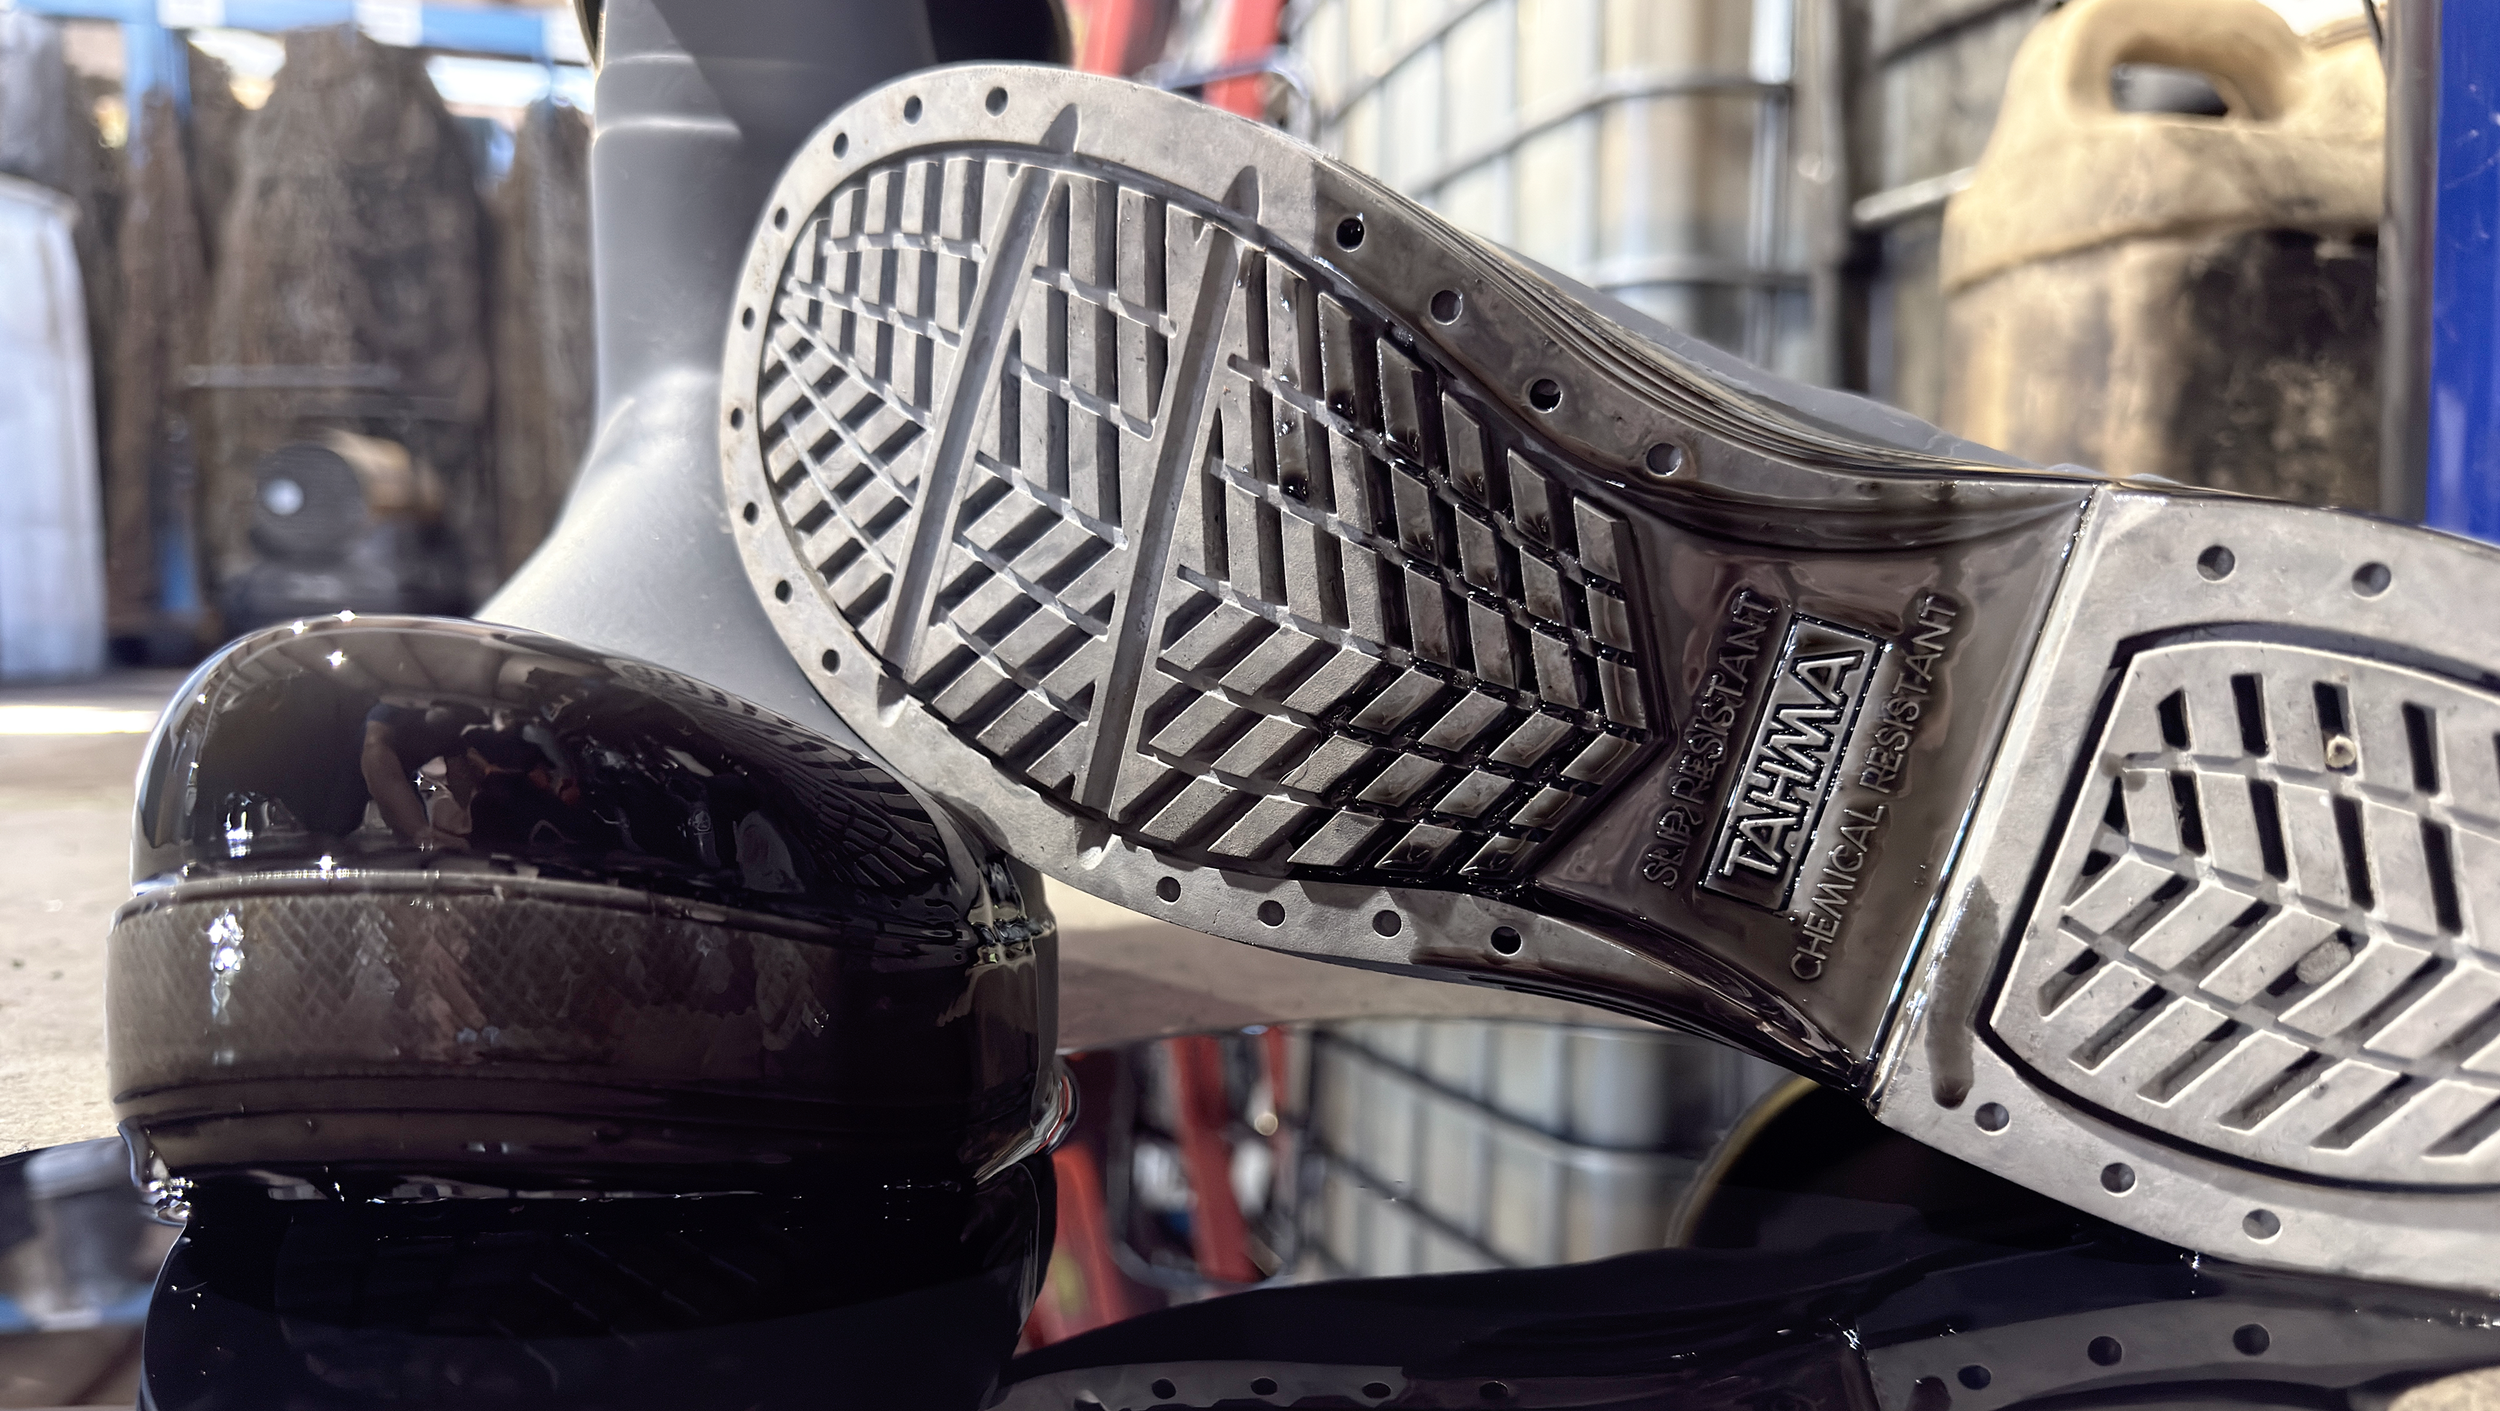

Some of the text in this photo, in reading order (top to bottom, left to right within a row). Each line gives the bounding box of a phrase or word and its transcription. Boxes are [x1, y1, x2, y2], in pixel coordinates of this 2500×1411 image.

[1643, 590, 1778, 888] SLIP RESISTANT
[1722, 652, 1864, 877] TAHMA
[1790, 594, 1957, 981] CHEMICAL RESISTANT
